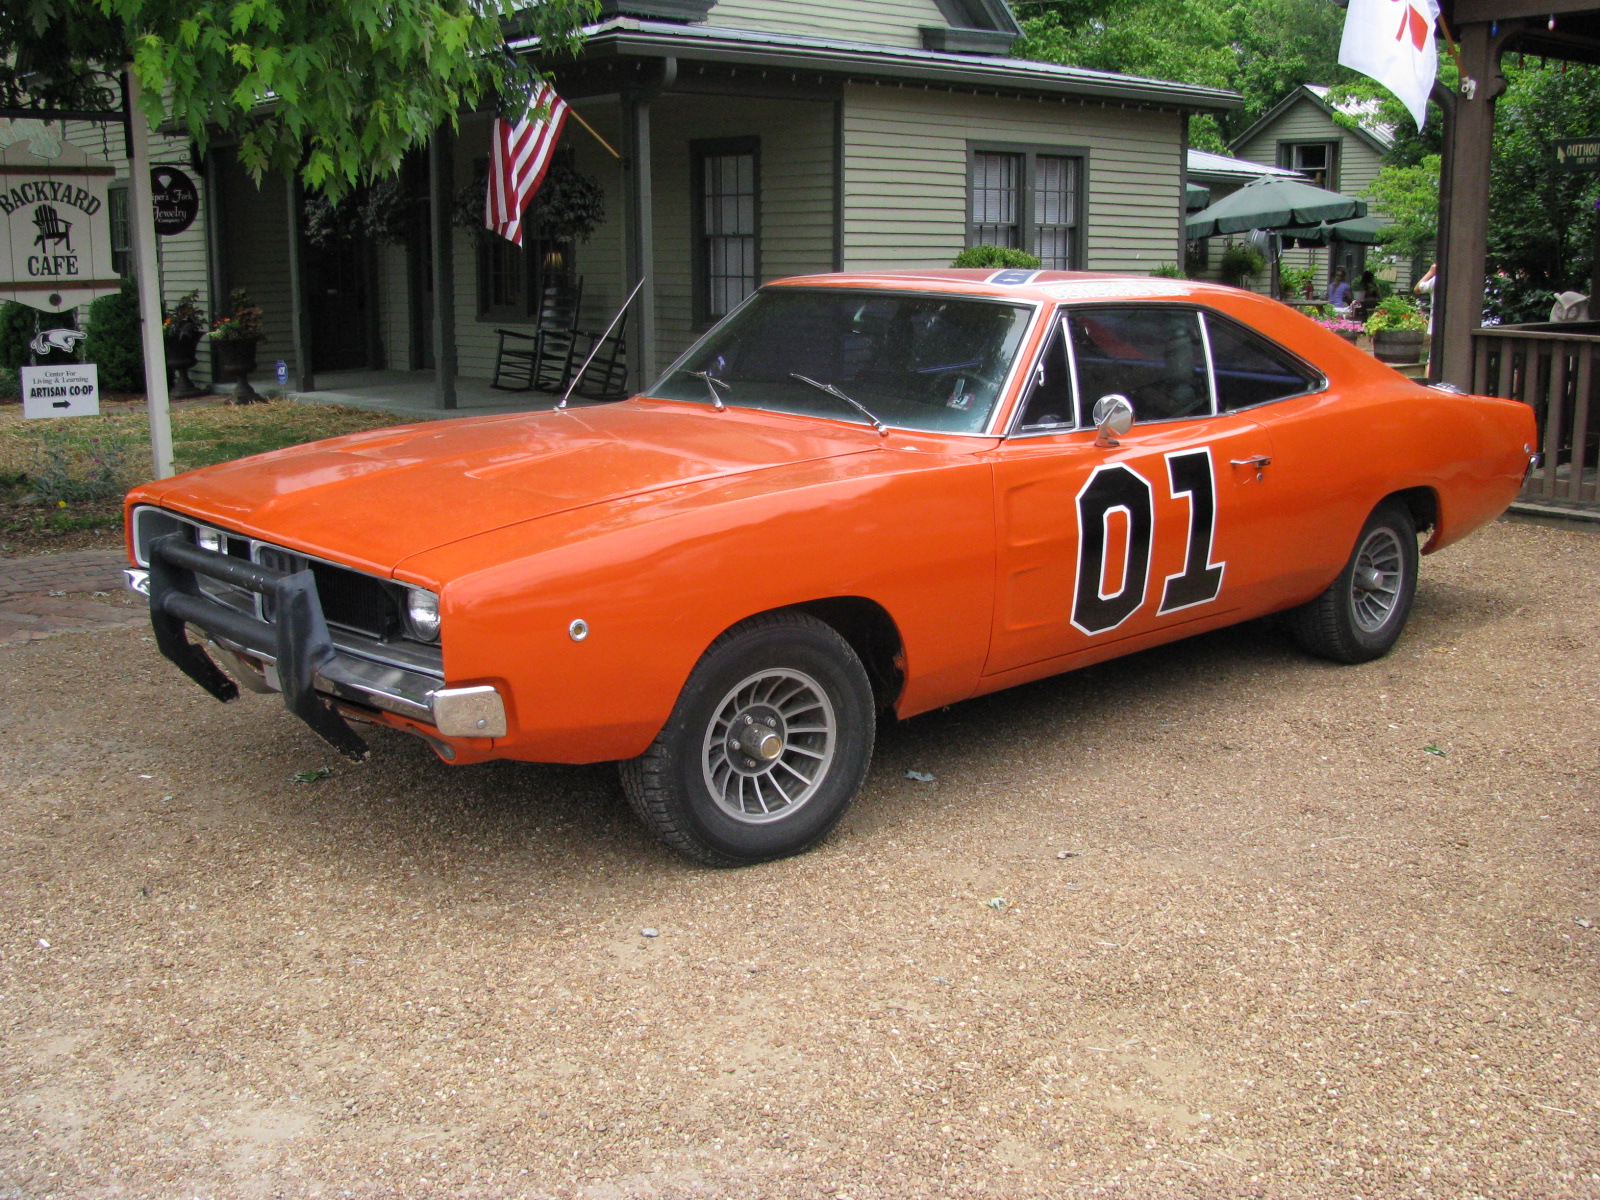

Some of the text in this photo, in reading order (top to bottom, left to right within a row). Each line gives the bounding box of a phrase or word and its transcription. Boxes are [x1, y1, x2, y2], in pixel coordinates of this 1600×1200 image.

[0, 181, 101, 216] BACKYARD
[172, 189, 193, 203] Fork
[153, 205, 187, 220] Jewelry
[27, 248, 79, 276] CAFÉ
[31, 385, 94, 397] ARTISAN CO-OP
[1070, 446, 1226, 637] 01
